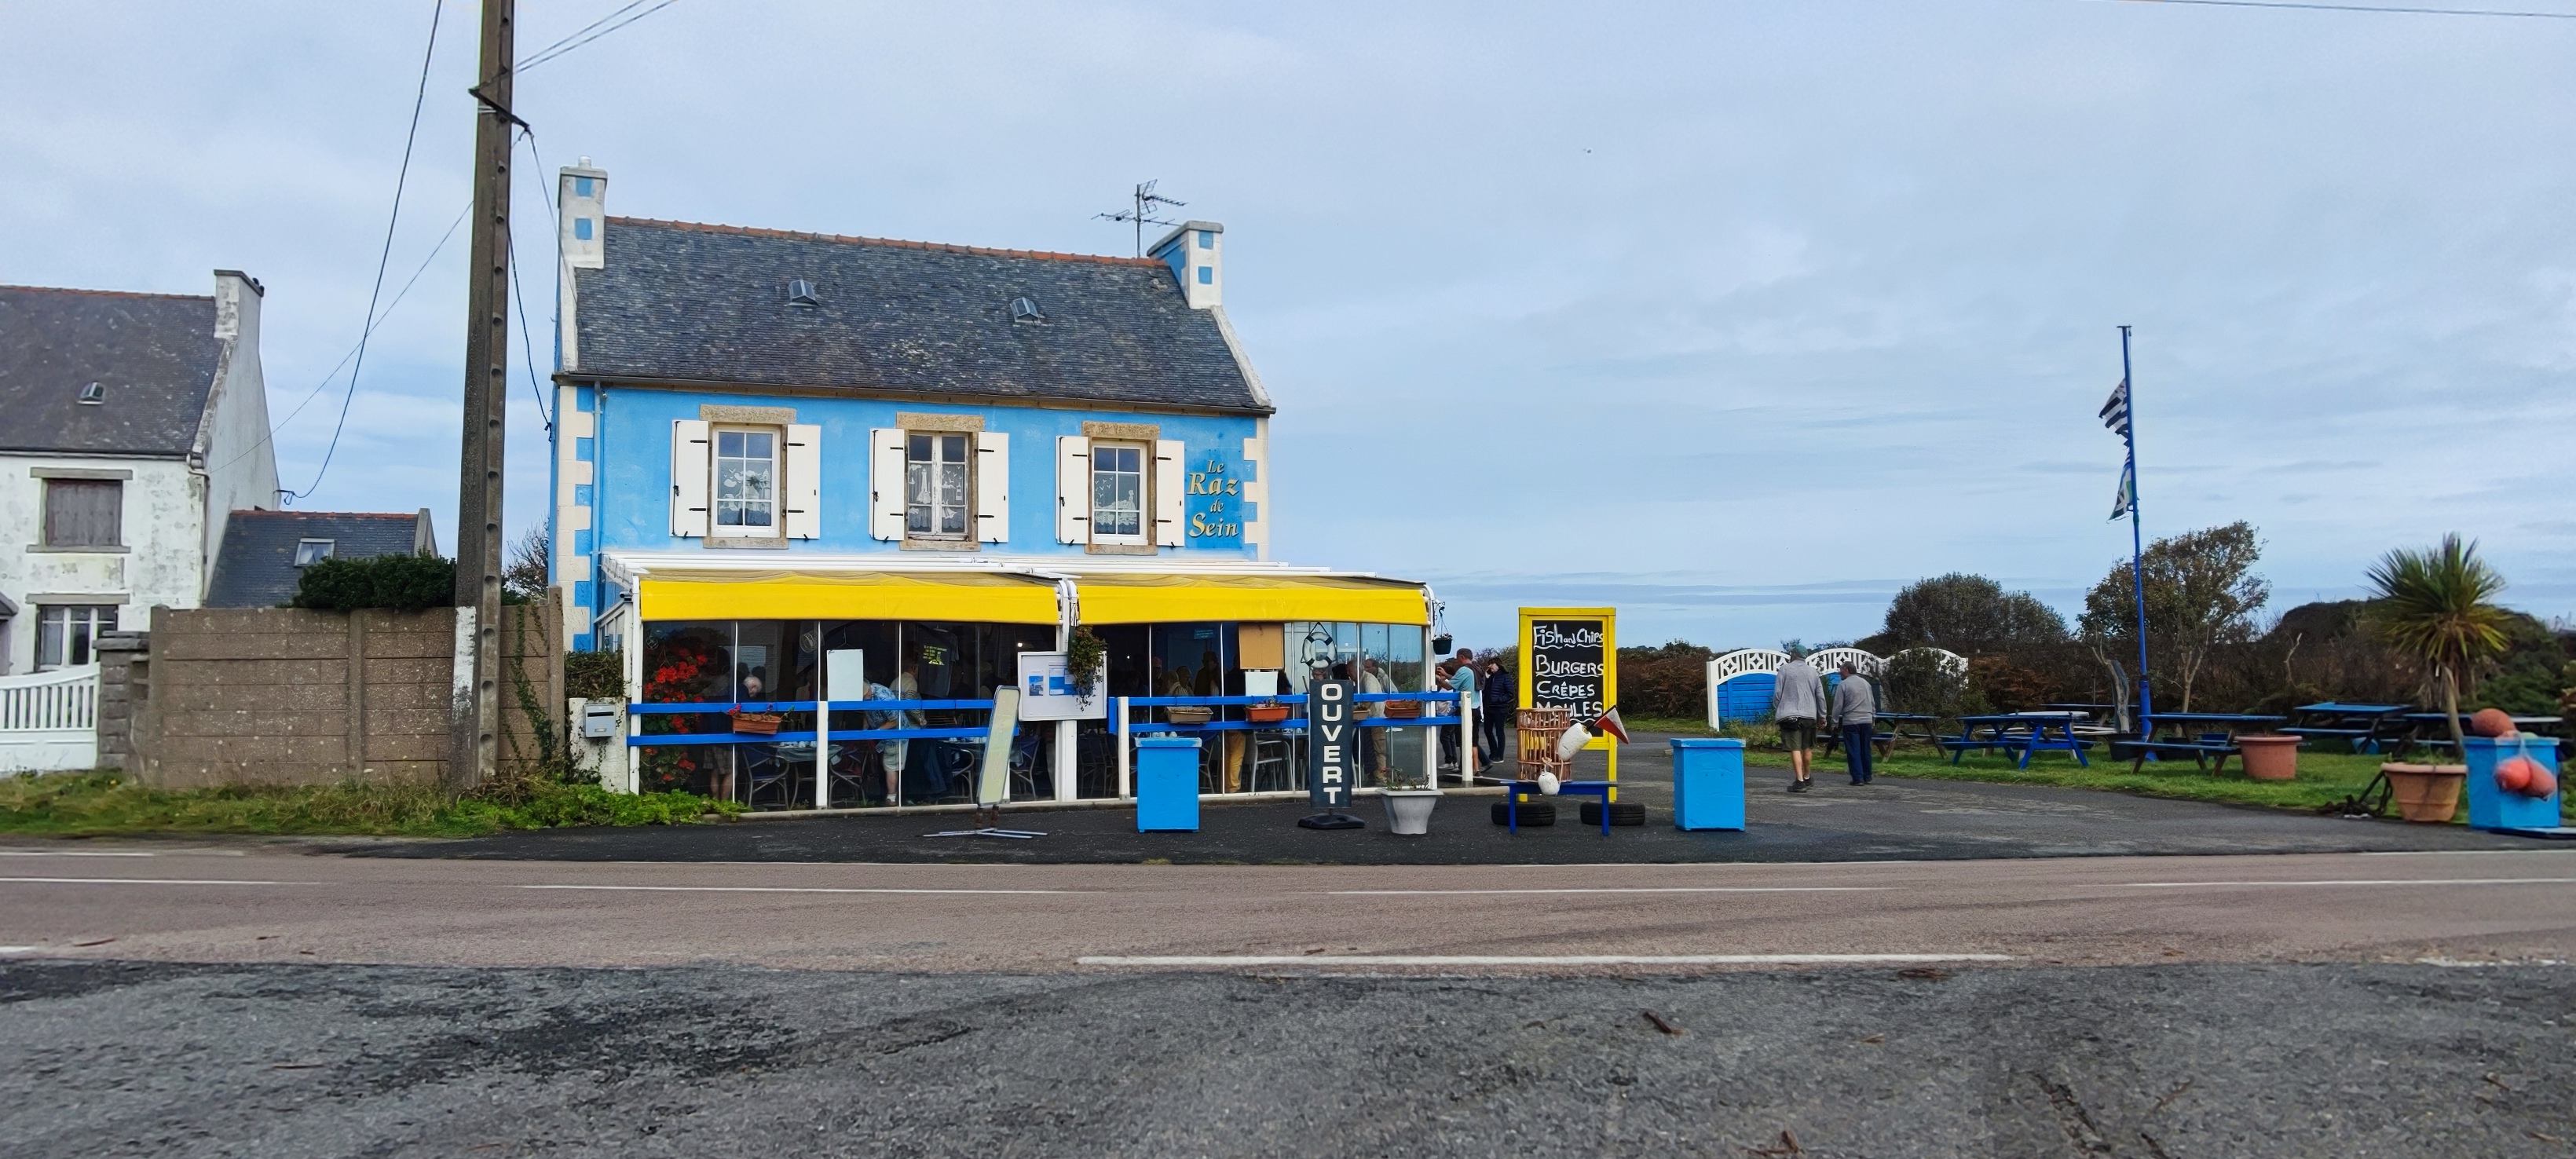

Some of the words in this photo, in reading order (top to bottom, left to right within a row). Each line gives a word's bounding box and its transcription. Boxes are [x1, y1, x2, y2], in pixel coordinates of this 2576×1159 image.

[1206, 459, 1224, 473] Le
[1187, 472, 1239, 495] Raz
[1210, 499, 1224, 513] de
[1188, 512, 1239, 538] Sein
[1533, 623, 1563, 645] Fish
[1563, 633, 1576, 644] and
[1535, 654, 1604, 675] BURGERS
[1536, 681, 1595, 696] CRÊPES
[1321, 683, 1343, 804] OUVERT
